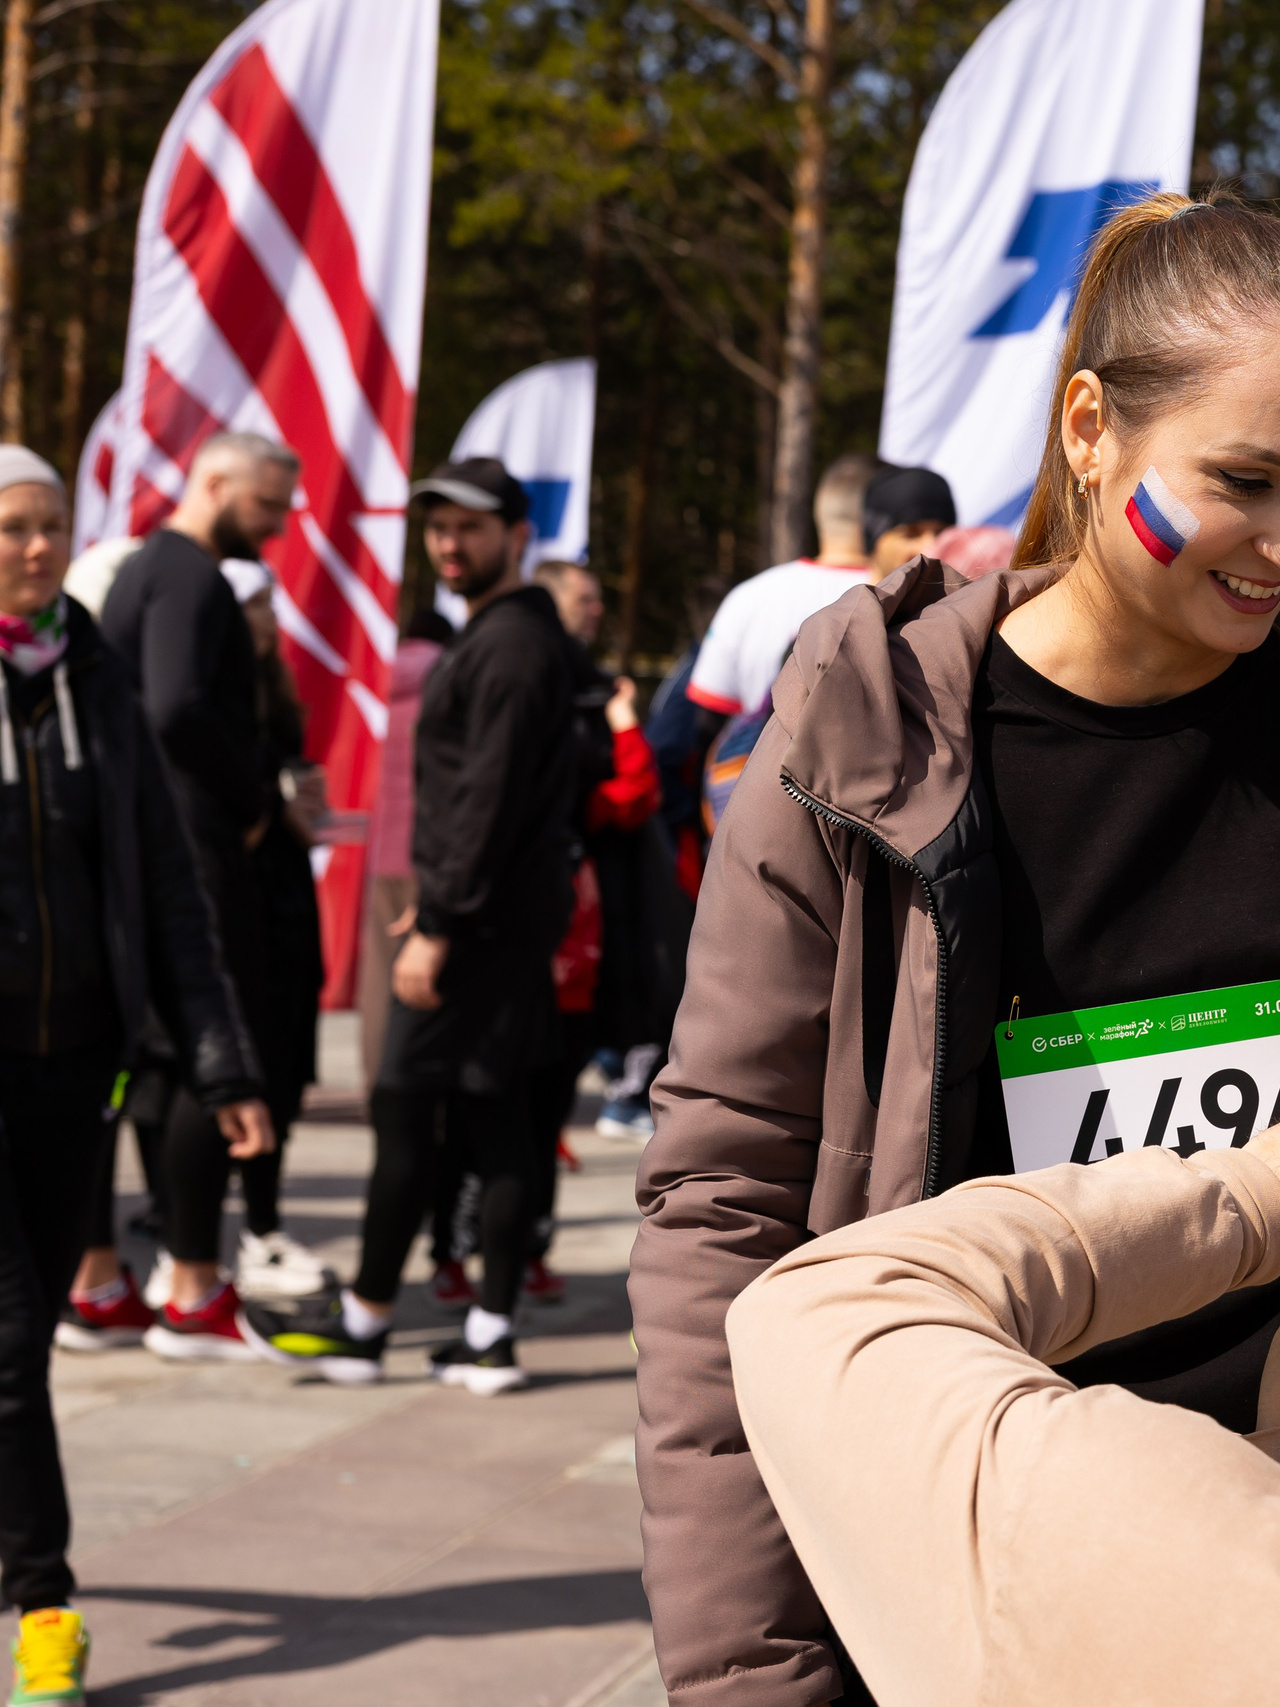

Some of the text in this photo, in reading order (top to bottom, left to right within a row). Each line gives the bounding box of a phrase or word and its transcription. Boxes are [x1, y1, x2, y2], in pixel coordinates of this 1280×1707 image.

[1188, 1008, 1227, 1023] ЦЕНТР
[1103, 1021, 1137, 1033] зелёный
[1049, 1033, 1083, 1048] СБЕР
[1099, 1030, 1135, 1041] марафон
